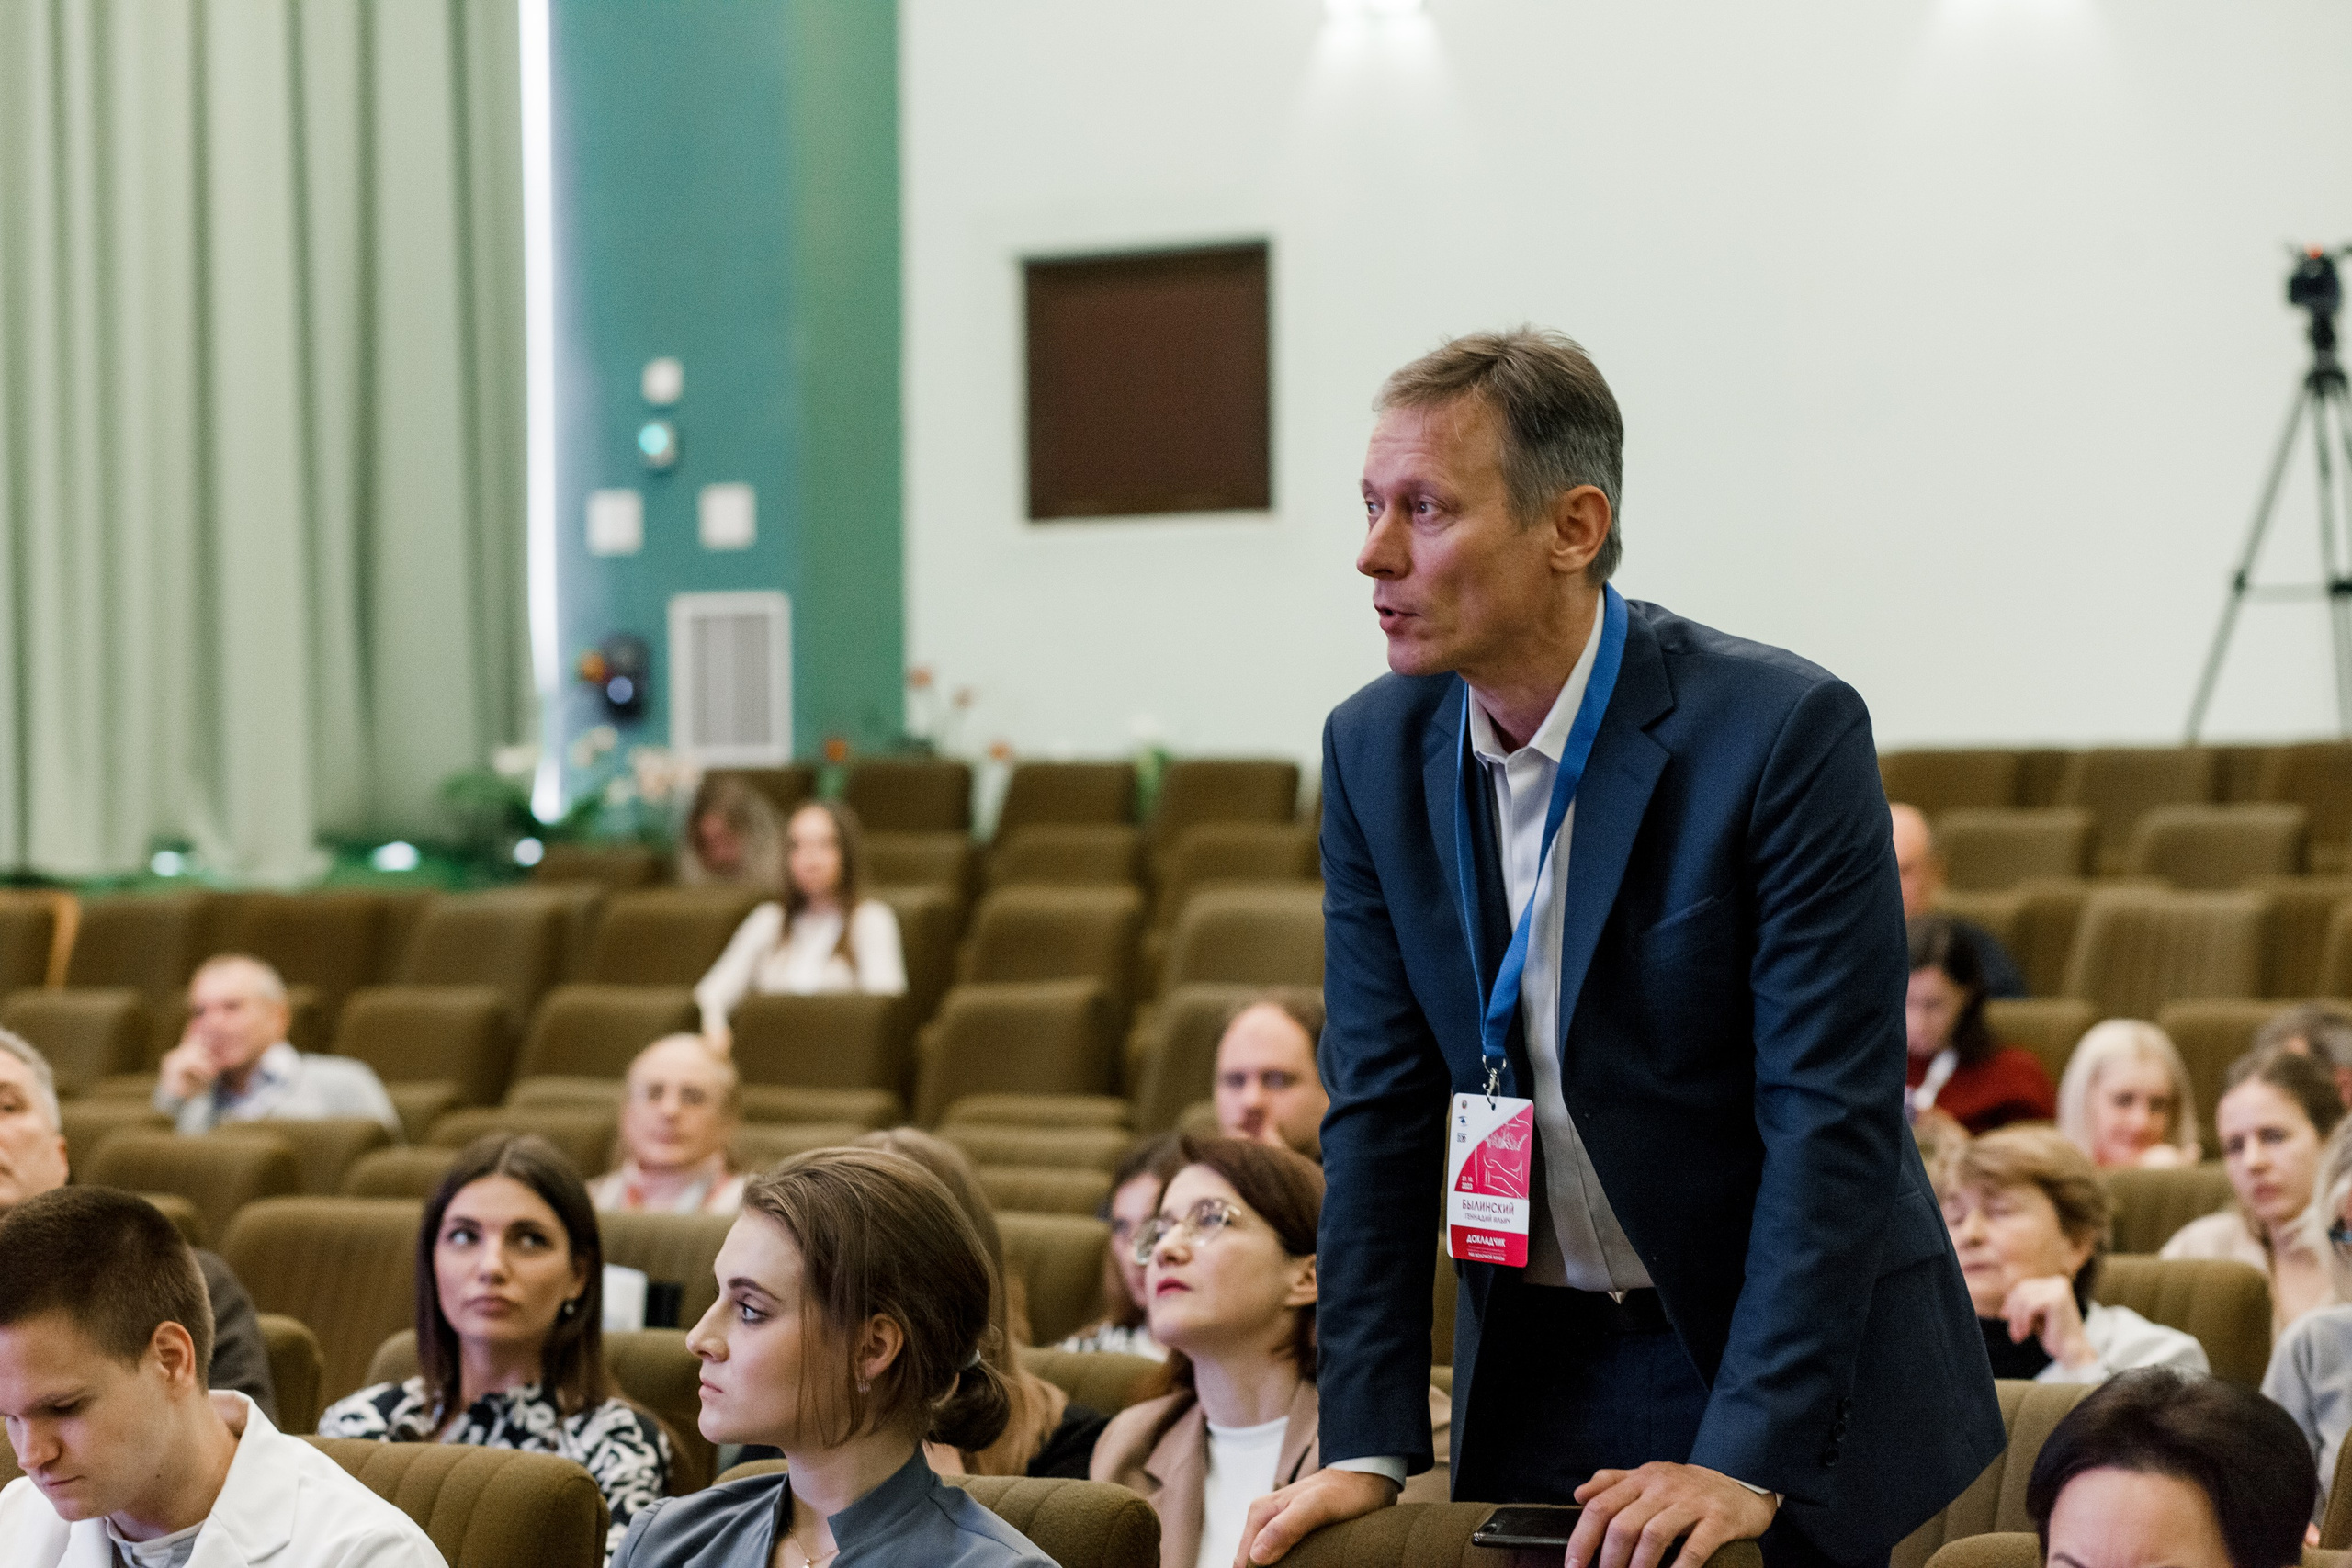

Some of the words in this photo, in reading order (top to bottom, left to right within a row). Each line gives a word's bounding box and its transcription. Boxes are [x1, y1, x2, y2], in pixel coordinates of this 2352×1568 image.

[1463, 1199, 1514, 1216] БЫЛИНСКИЙ
[1464, 1213, 1492, 1222] ГЕННАДИЙ
[1466, 1234, 1506, 1247] ДОКЛАДЧИК
